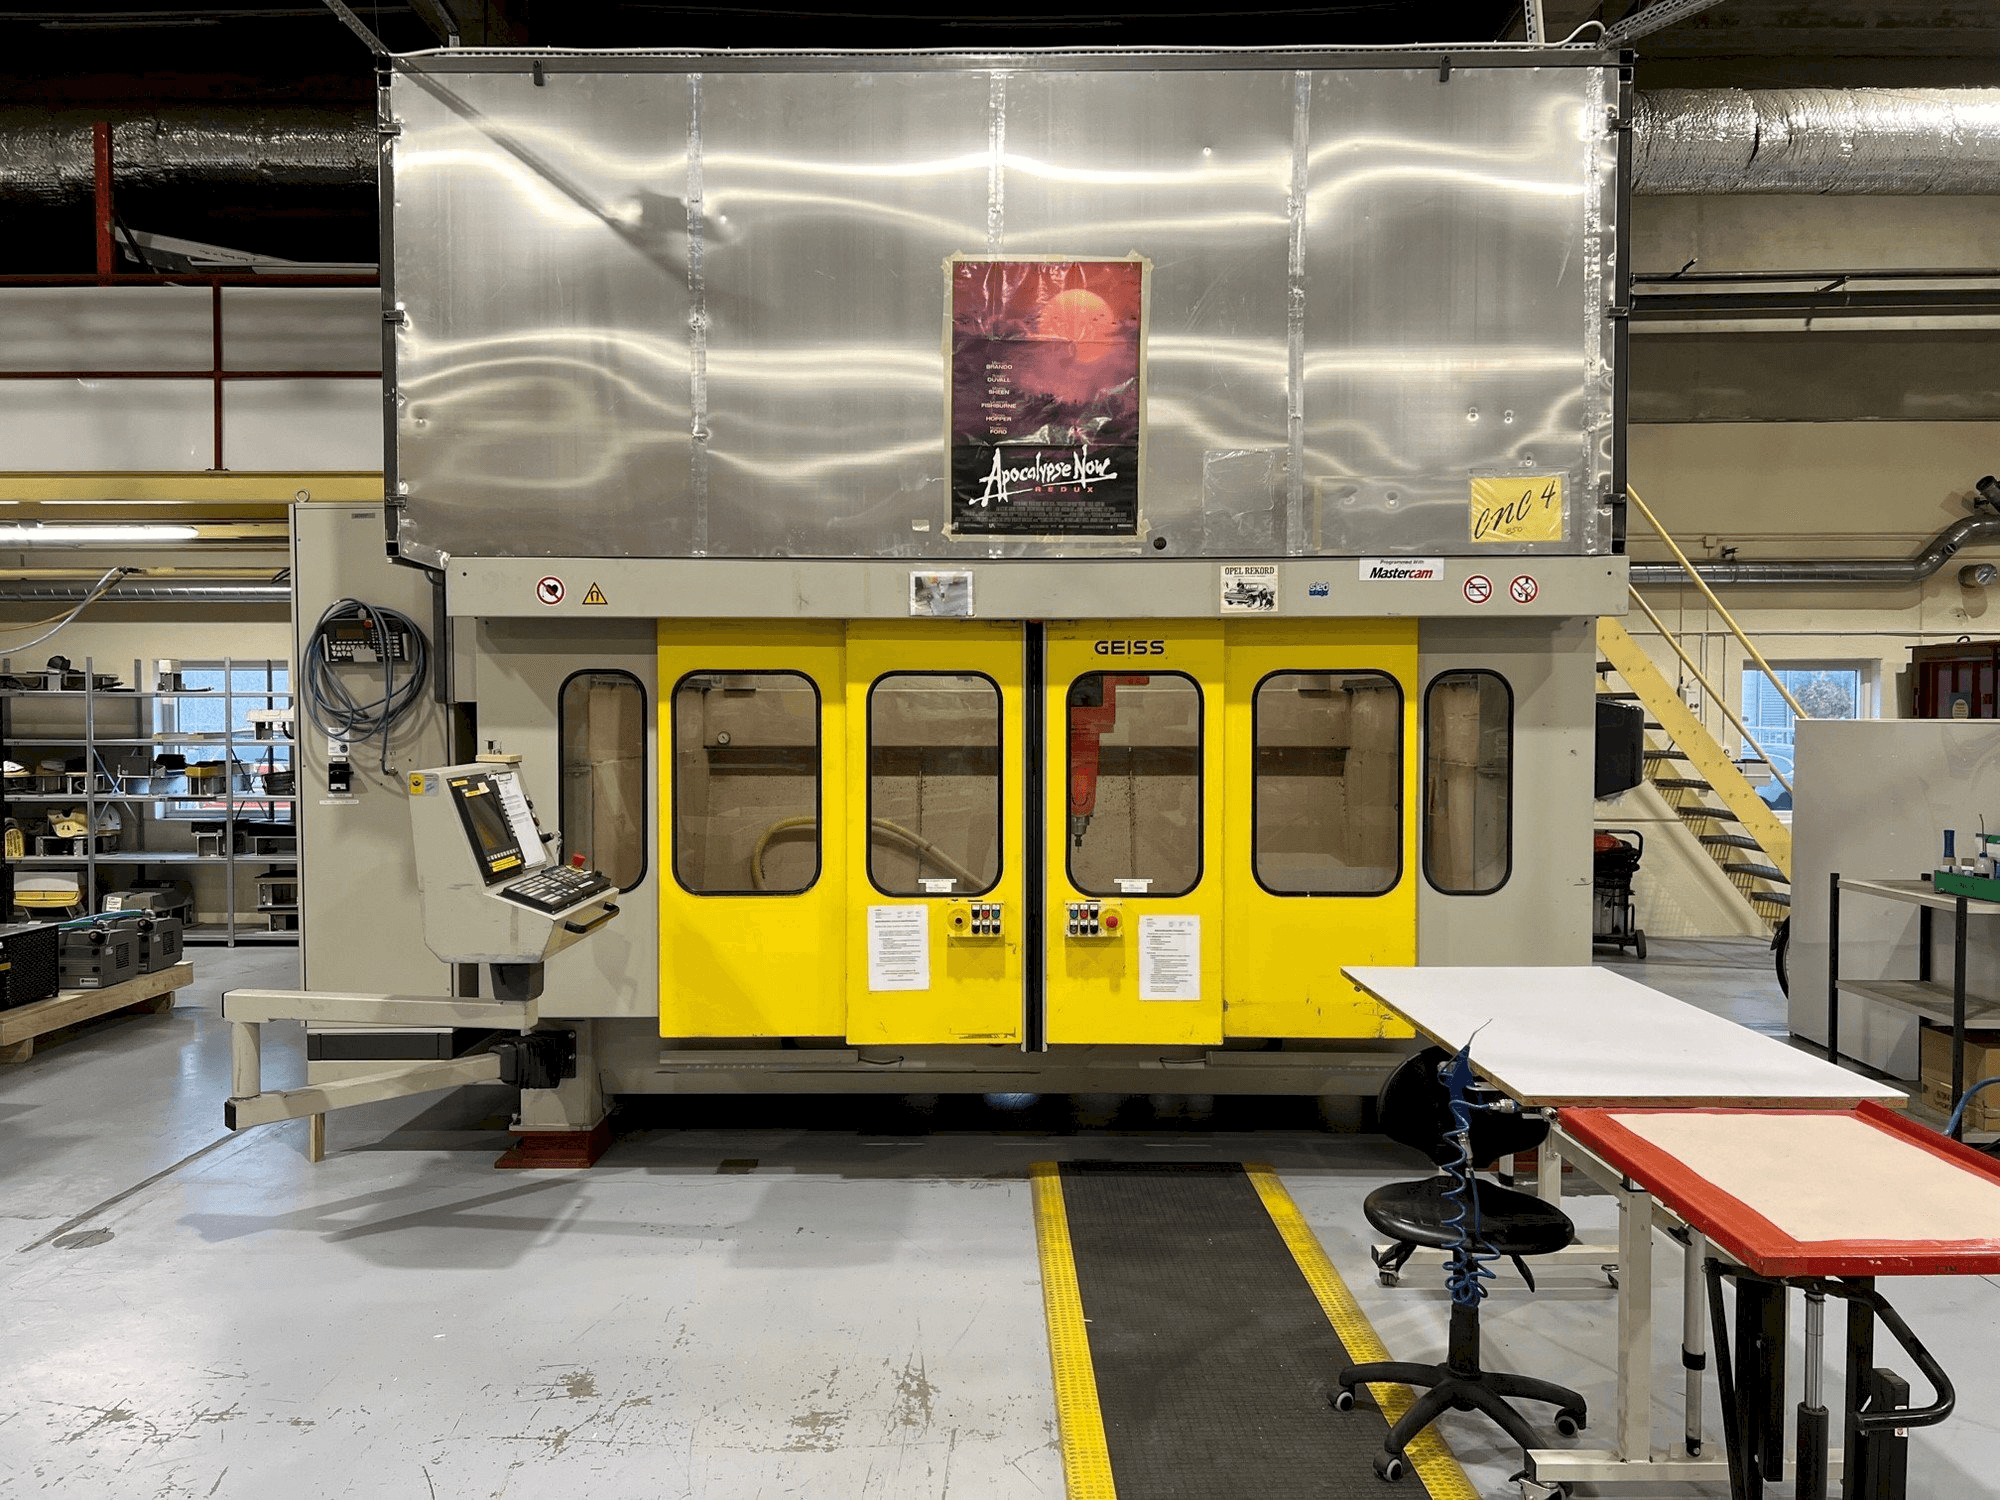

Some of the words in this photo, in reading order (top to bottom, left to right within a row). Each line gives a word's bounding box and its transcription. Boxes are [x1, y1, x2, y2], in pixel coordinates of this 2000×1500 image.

[977, 448, 1072, 508] Apocalypse
[1073, 444, 1113, 489] Now
[1540, 480, 1556, 509] 4
[1224, 566, 1244, 575] OPEL
[1244, 566, 1275, 575] REKORD
[1369, 567, 1434, 579] Mastercam
[1094, 640, 1165, 655] GEISS
